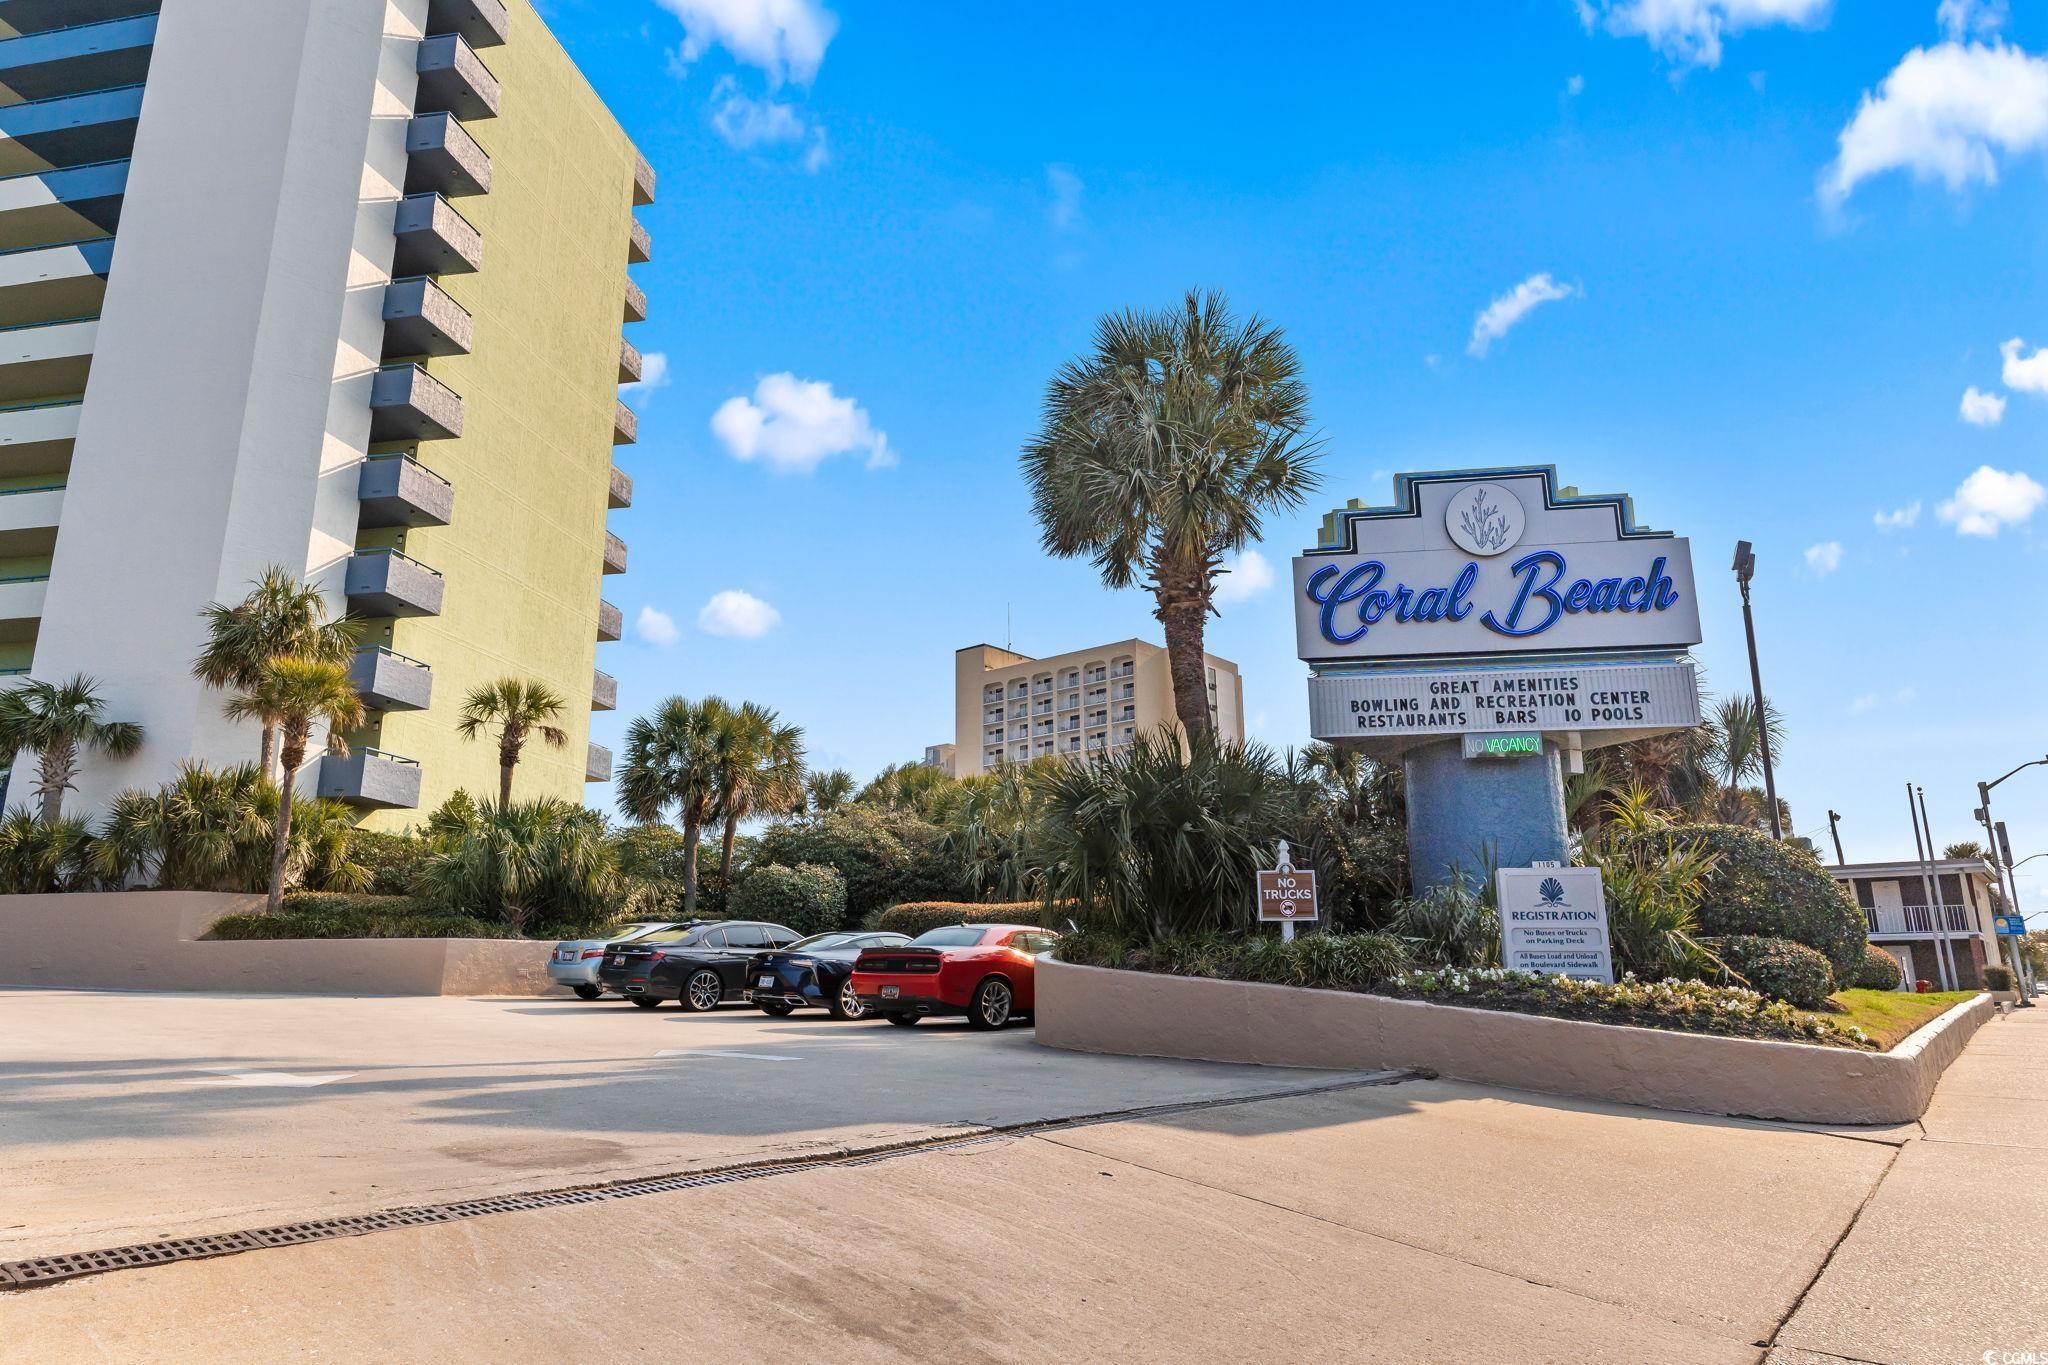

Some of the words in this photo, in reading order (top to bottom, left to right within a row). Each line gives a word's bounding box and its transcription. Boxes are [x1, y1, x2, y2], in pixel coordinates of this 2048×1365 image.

[1306, 561, 1479, 645] Coral
[1480, 550, 1679, 637] Beach
[1430, 680, 1479, 694] GREAT
[1493, 677, 1579, 692] AMENITIES
[1351, 698, 1419, 713] BOWLING
[1430, 697, 1460, 710] AND
[1475, 693, 1576, 709] RECREATION
[1590, 690, 1651, 705] CENTER
[1357, 712, 1467, 729] RESTAURANTS
[1496, 710, 1537, 724] BARS
[1591, 707, 1643, 721] POOLS
[1465, 739, 1484, 753] NO
[1485, 737, 1541, 753] VACANCY
[1278, 878, 1296, 888] NO
[1264, 890, 1312, 900] TRUCKS
[1512, 911, 1597, 921] REGISTRATION
